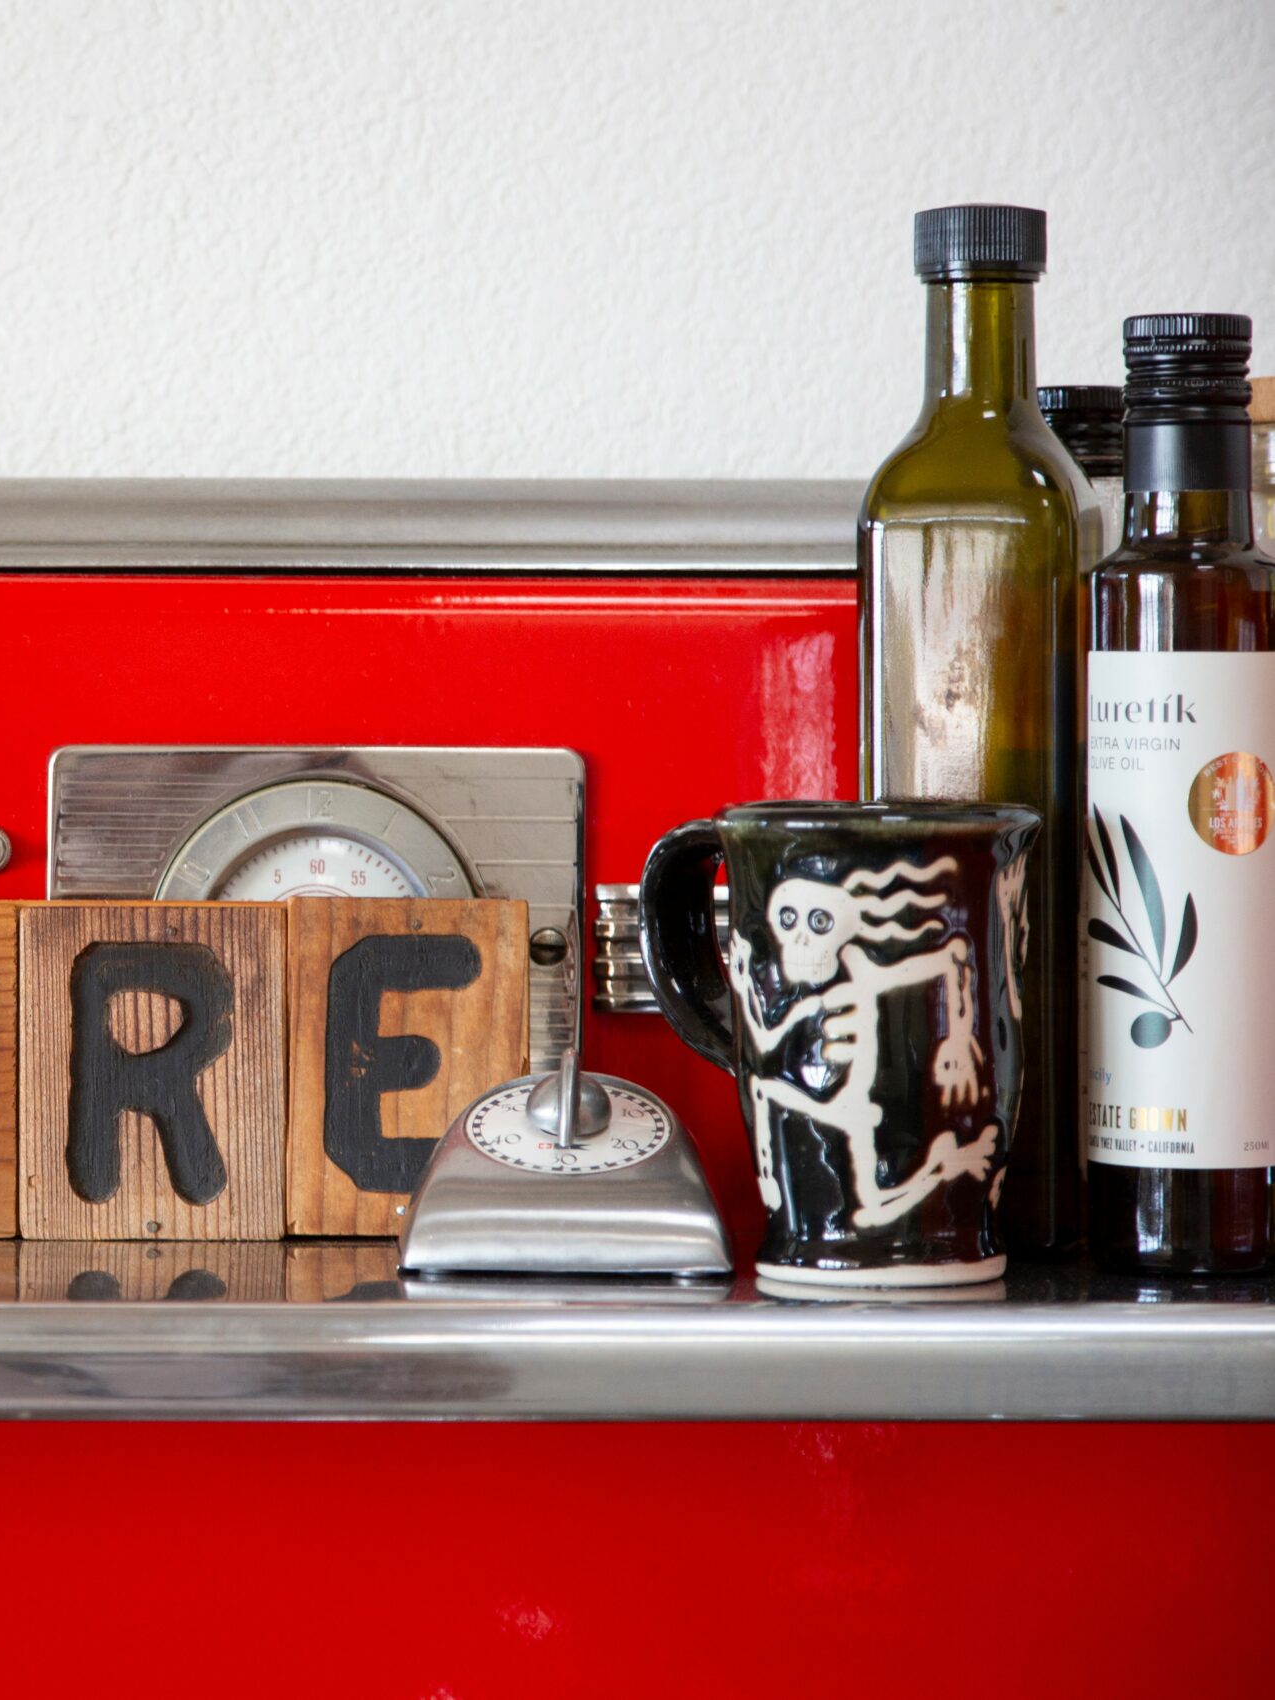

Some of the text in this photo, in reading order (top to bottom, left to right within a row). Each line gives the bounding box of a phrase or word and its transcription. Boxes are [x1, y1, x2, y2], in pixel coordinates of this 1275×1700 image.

[1090, 736, 1181, 752] EXTRA VIRGIN
[1090, 756, 1146, 771] OLIVE OIL
[306, 787, 334, 820] 12
[1209, 816, 1227, 829] LOS
[309, 858, 326, 875] 60
[273, 868, 282, 885] 5
[350, 870, 367, 886] 55
[501, 1103, 527, 1113] 50
[621, 1107, 645, 1119] 10
[1088, 1102, 1122, 1129] ESTATE
[492, 1133, 522, 1145] 40
[611, 1137, 640, 1151] 20
[1115, 1138, 1137, 1152] VALLEY
[1148, 1140, 1196, 1155] CALIFORNIA
[551, 1153, 578, 1166] 30
